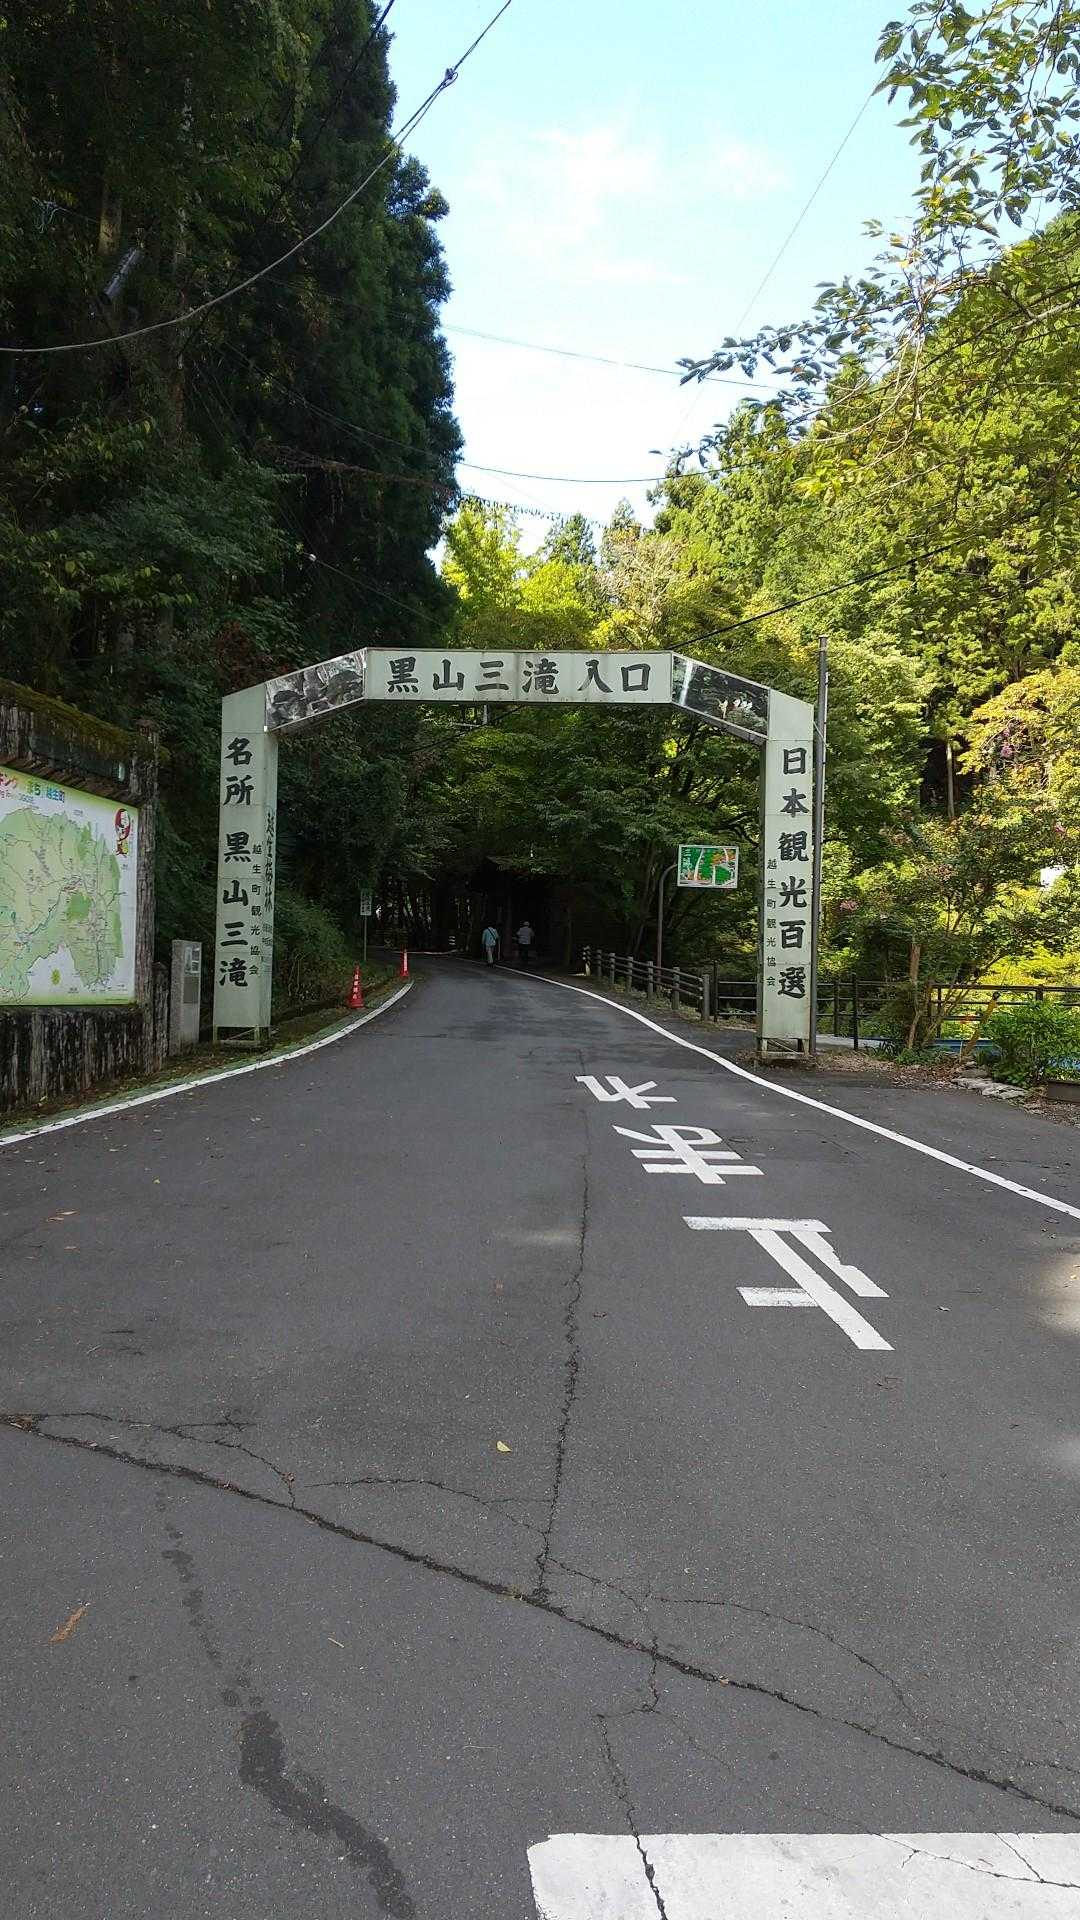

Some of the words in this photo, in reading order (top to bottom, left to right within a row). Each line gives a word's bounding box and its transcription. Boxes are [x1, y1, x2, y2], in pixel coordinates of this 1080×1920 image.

[387, 656, 651, 695] 黒山三滝入口
[249, 844, 262, 976] 越生町観光協会
[766, 859, 777, 987] 越生町観光協会
[777, 747, 810, 999] 日本観光百選
